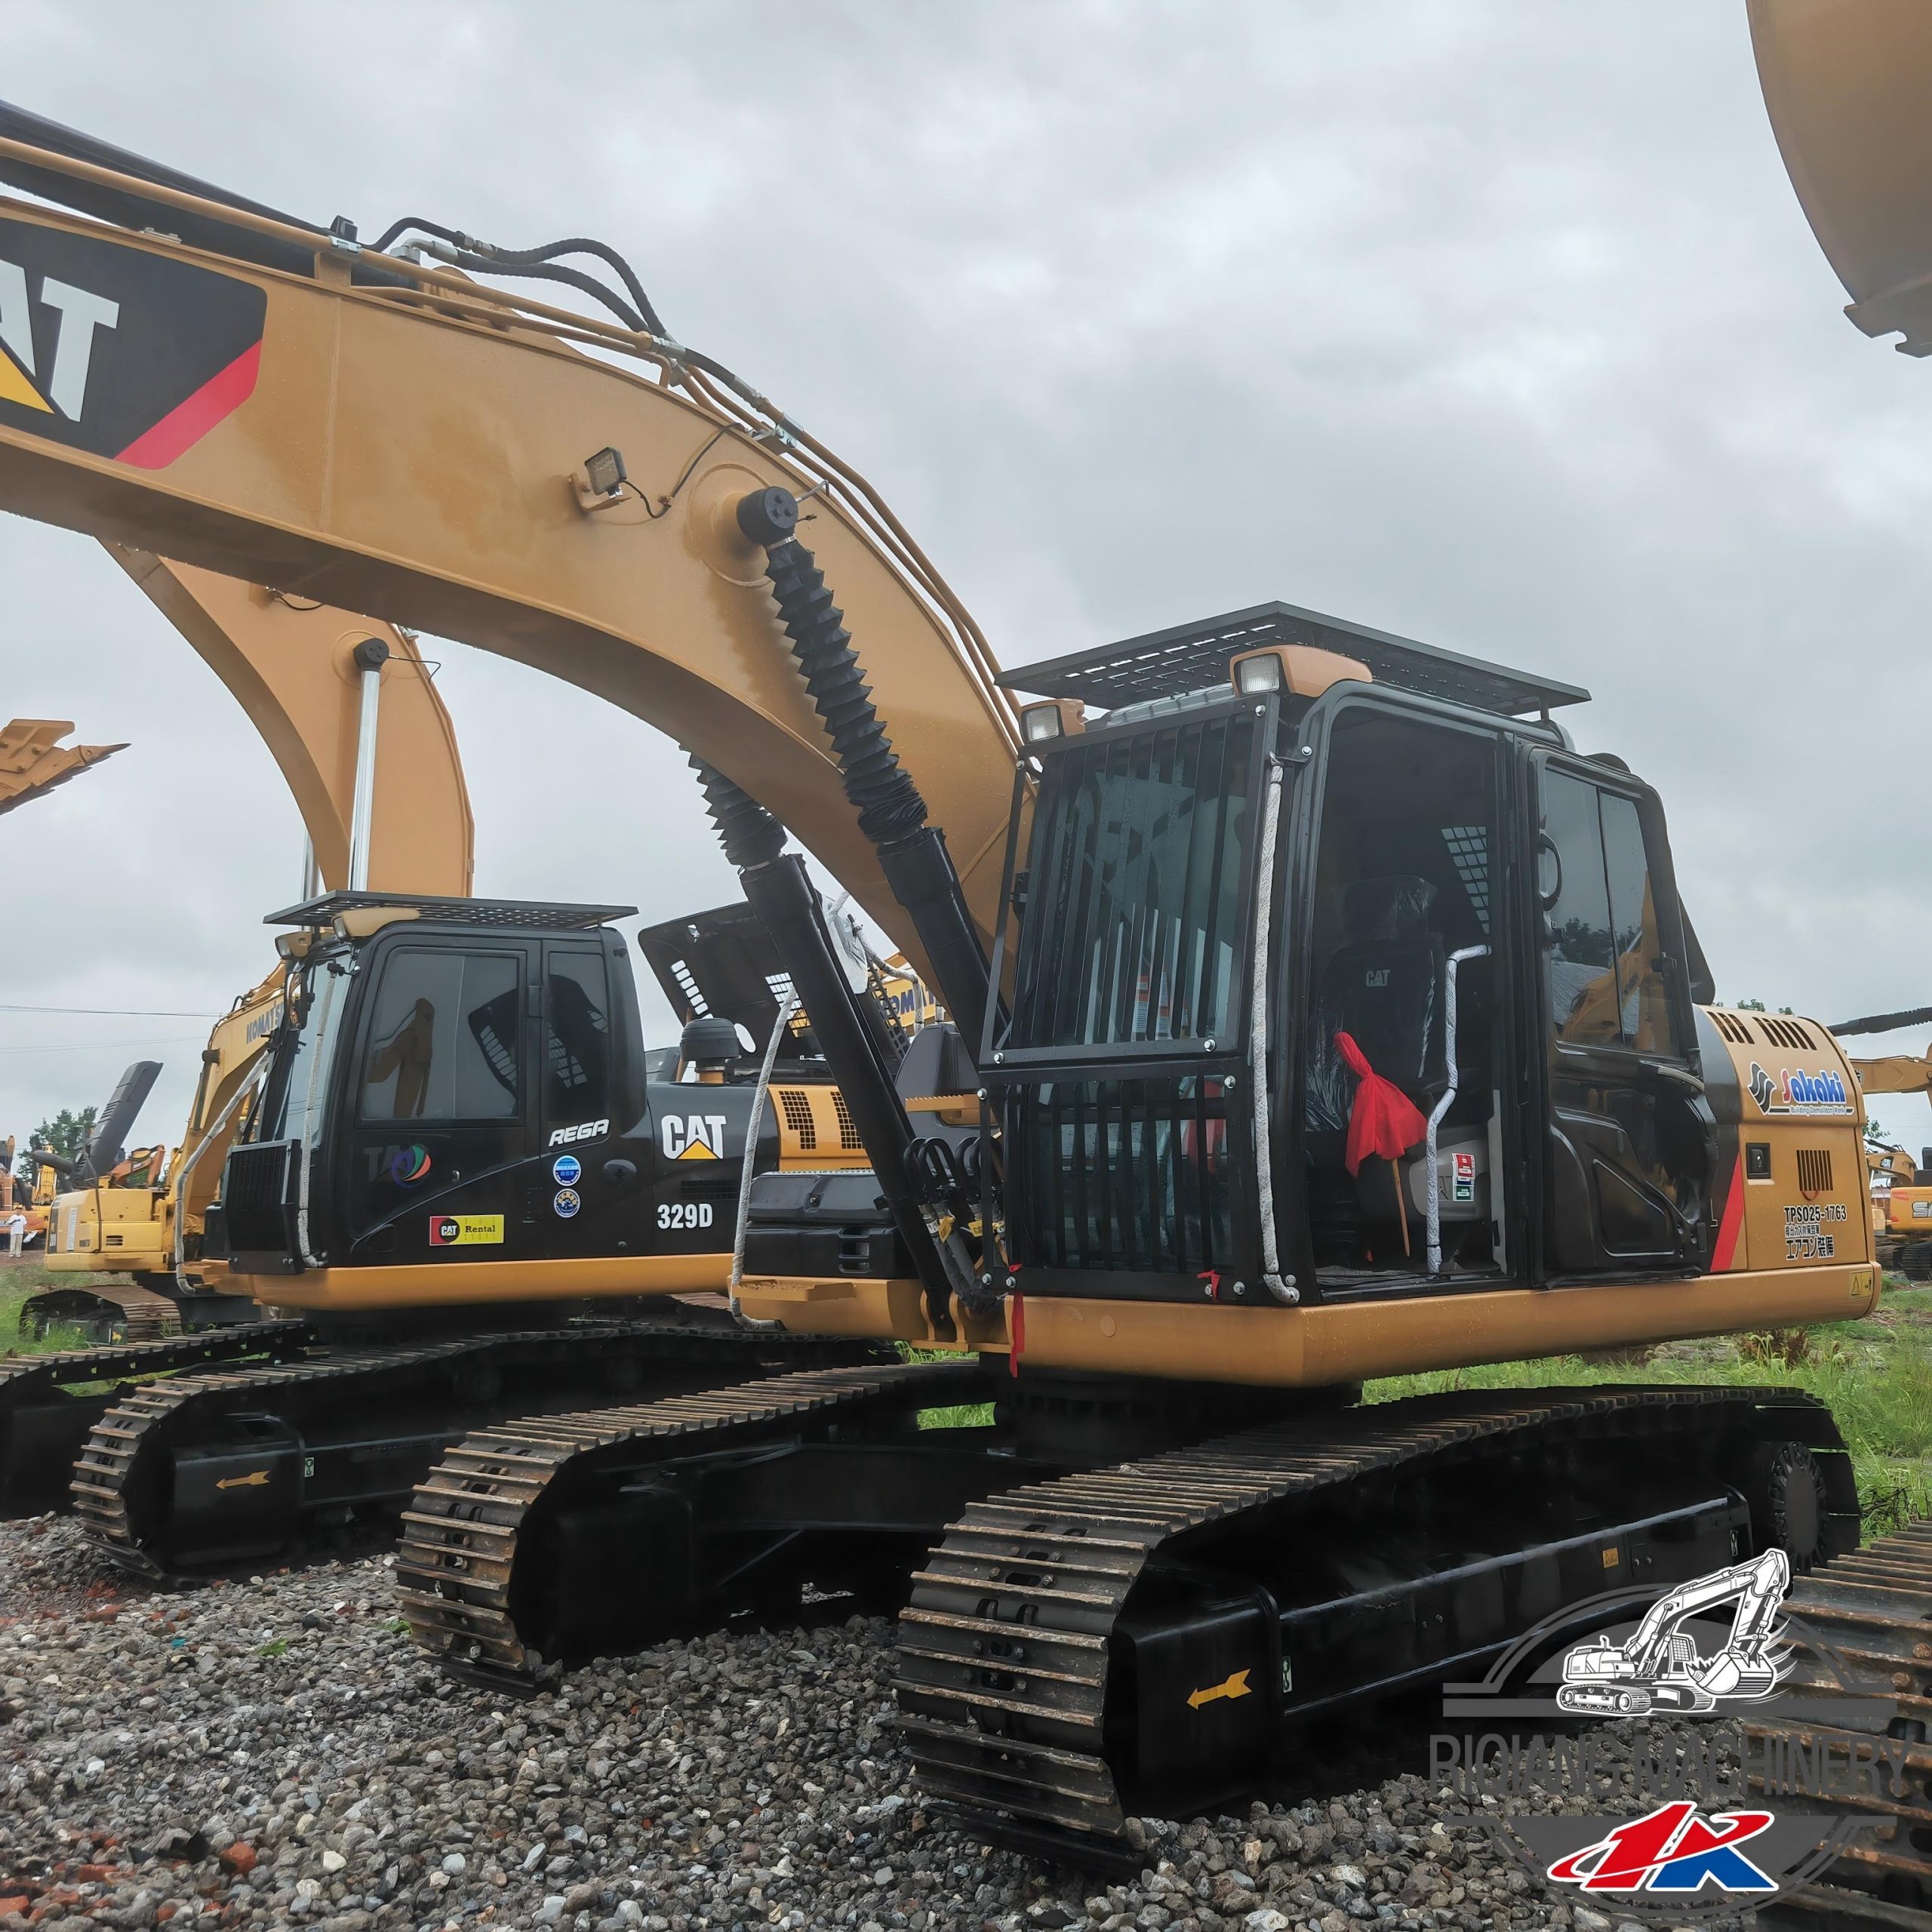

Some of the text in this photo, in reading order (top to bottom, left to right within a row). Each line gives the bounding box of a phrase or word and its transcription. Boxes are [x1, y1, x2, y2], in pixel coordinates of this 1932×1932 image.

[1366, 969, 1391, 987] CAT
[1781, 1069, 1846, 1103] Sakaki
[549, 1118, 610, 1147] REGA
[661, 1115, 727, 1160] CAT
[657, 1203, 713, 1229] 329D
[1784, 1204, 1847, 1223] TPS025-1763
[441, 1225, 496, 1237] CAT Rental
